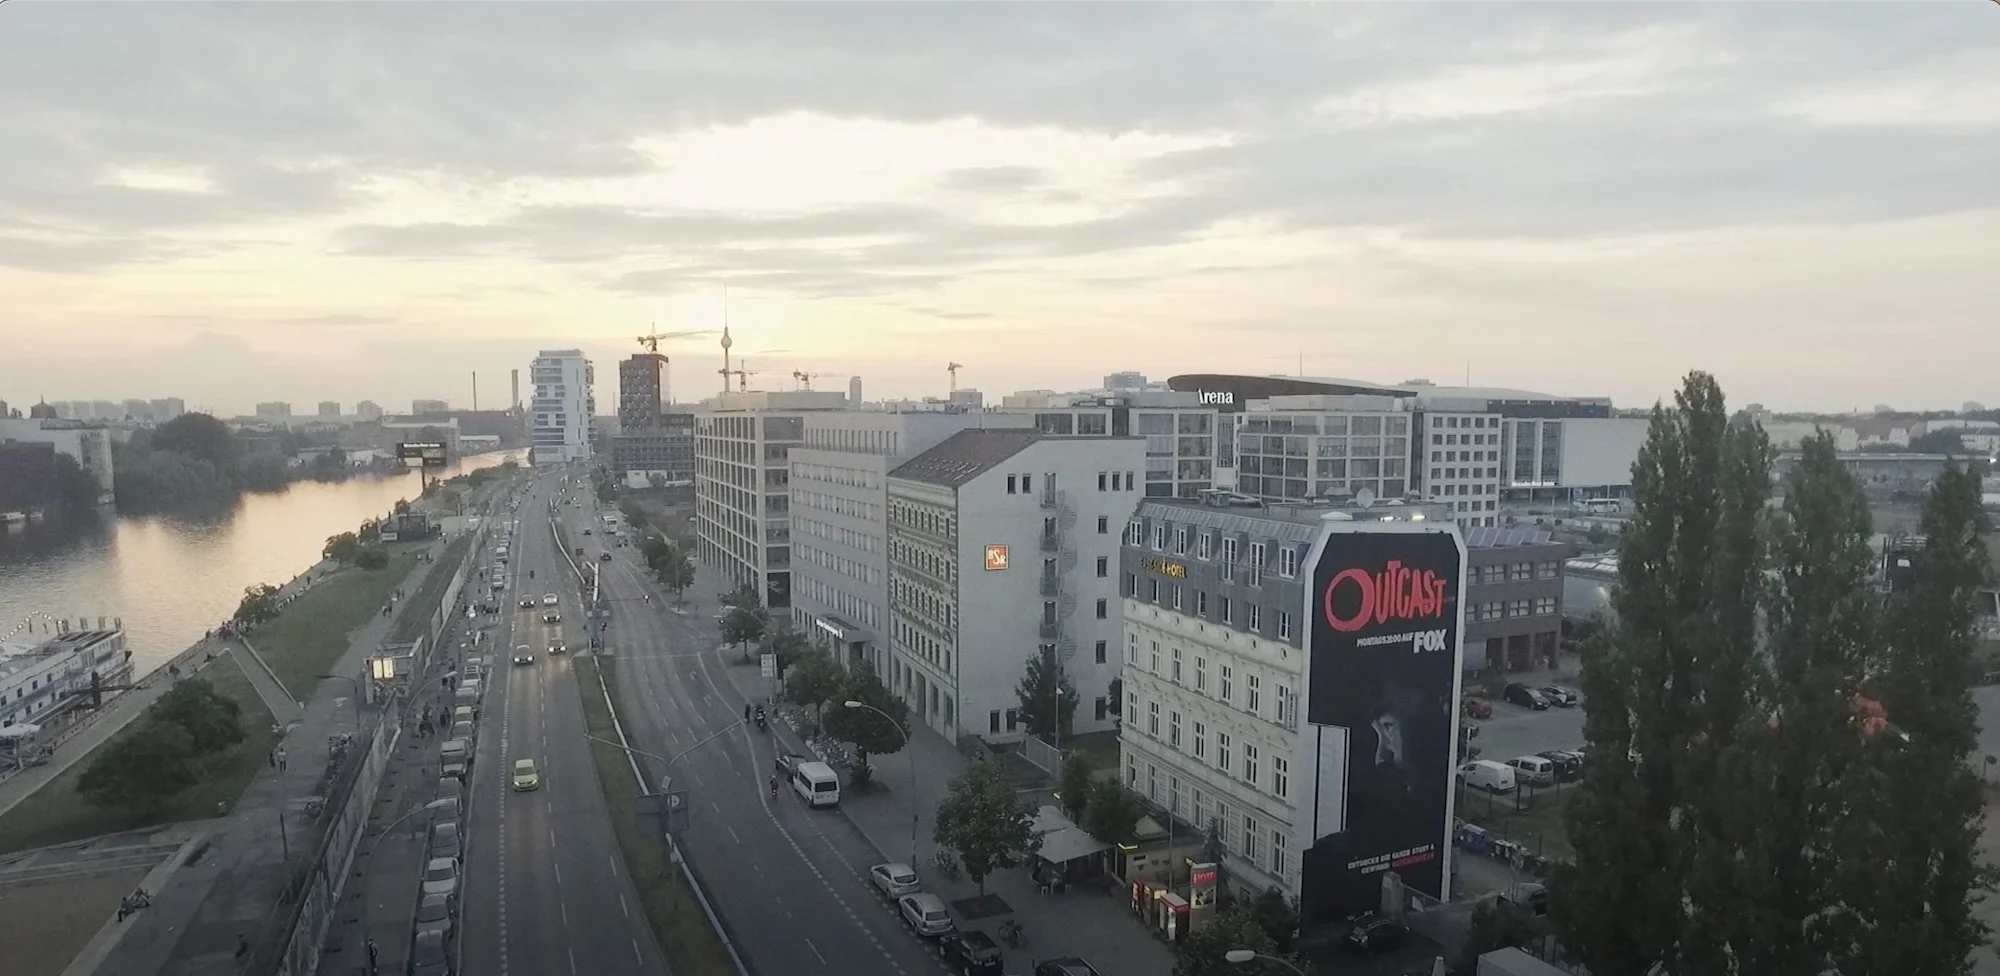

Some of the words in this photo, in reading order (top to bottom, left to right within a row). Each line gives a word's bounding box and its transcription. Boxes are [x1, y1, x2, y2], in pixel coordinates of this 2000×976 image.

[988, 549, 1006, 565] BSR
[1325, 560, 1447, 632] OUTCAST
[1413, 628, 1448, 653] FOX
